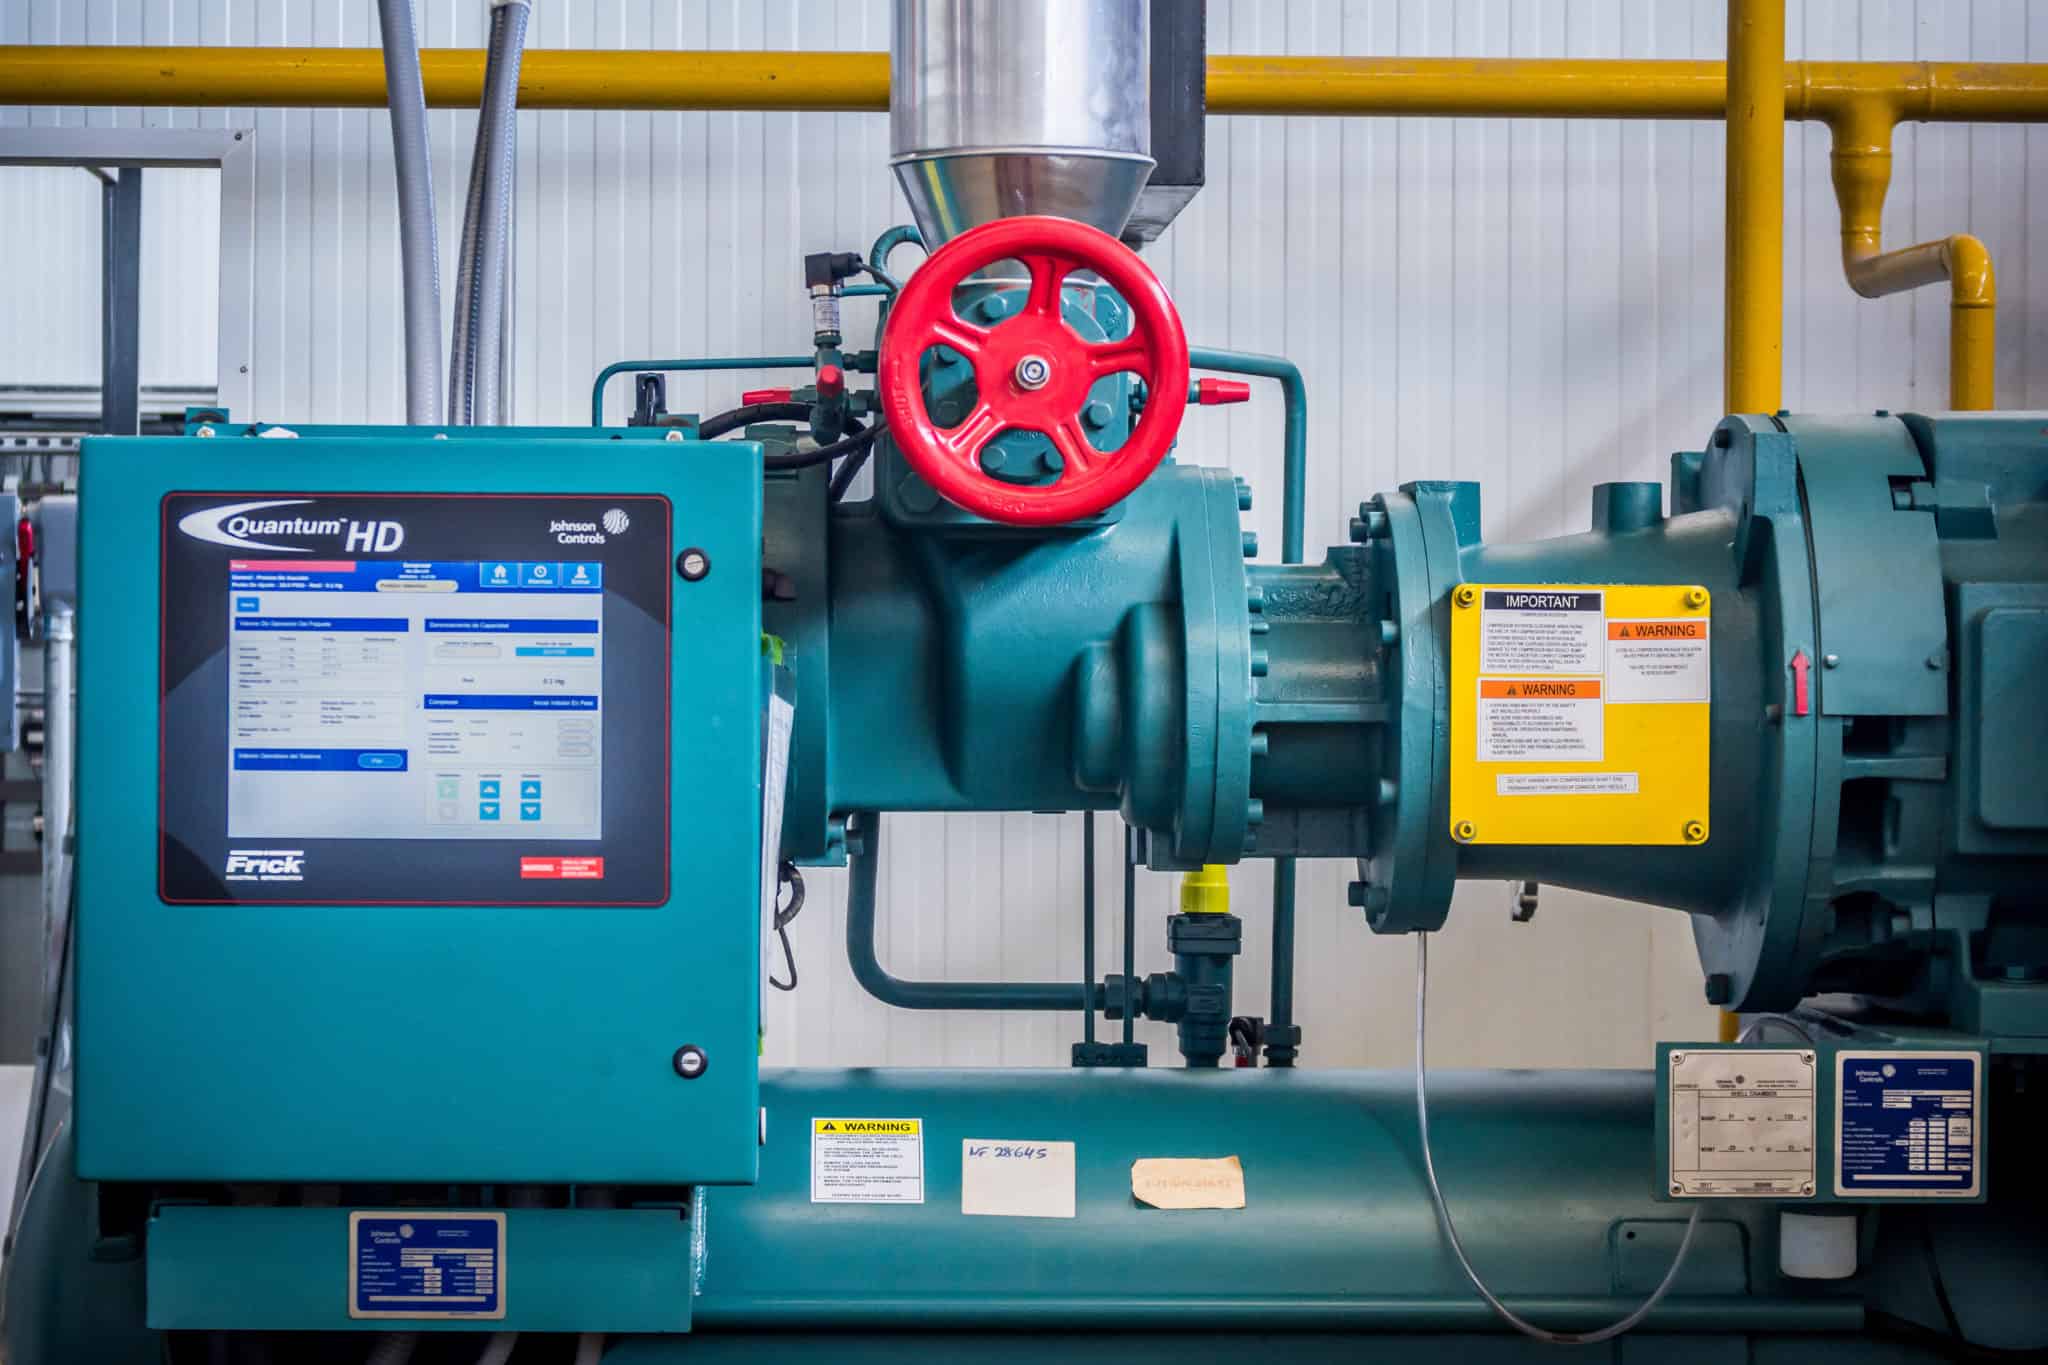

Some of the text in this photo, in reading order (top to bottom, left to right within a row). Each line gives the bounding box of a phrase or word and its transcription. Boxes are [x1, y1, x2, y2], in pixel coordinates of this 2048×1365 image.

[549, 519, 596, 533] Johnson
[345, 521, 404, 552] HD
[557, 532, 605, 544] Controls
[1505, 595, 1580, 609] IMPORTANT
[1635, 624, 1696, 637] WARNING
[1522, 684, 1576, 696] WARNING
[226, 851, 304, 874] Frick
[844, 1122, 911, 1131] WARNING
